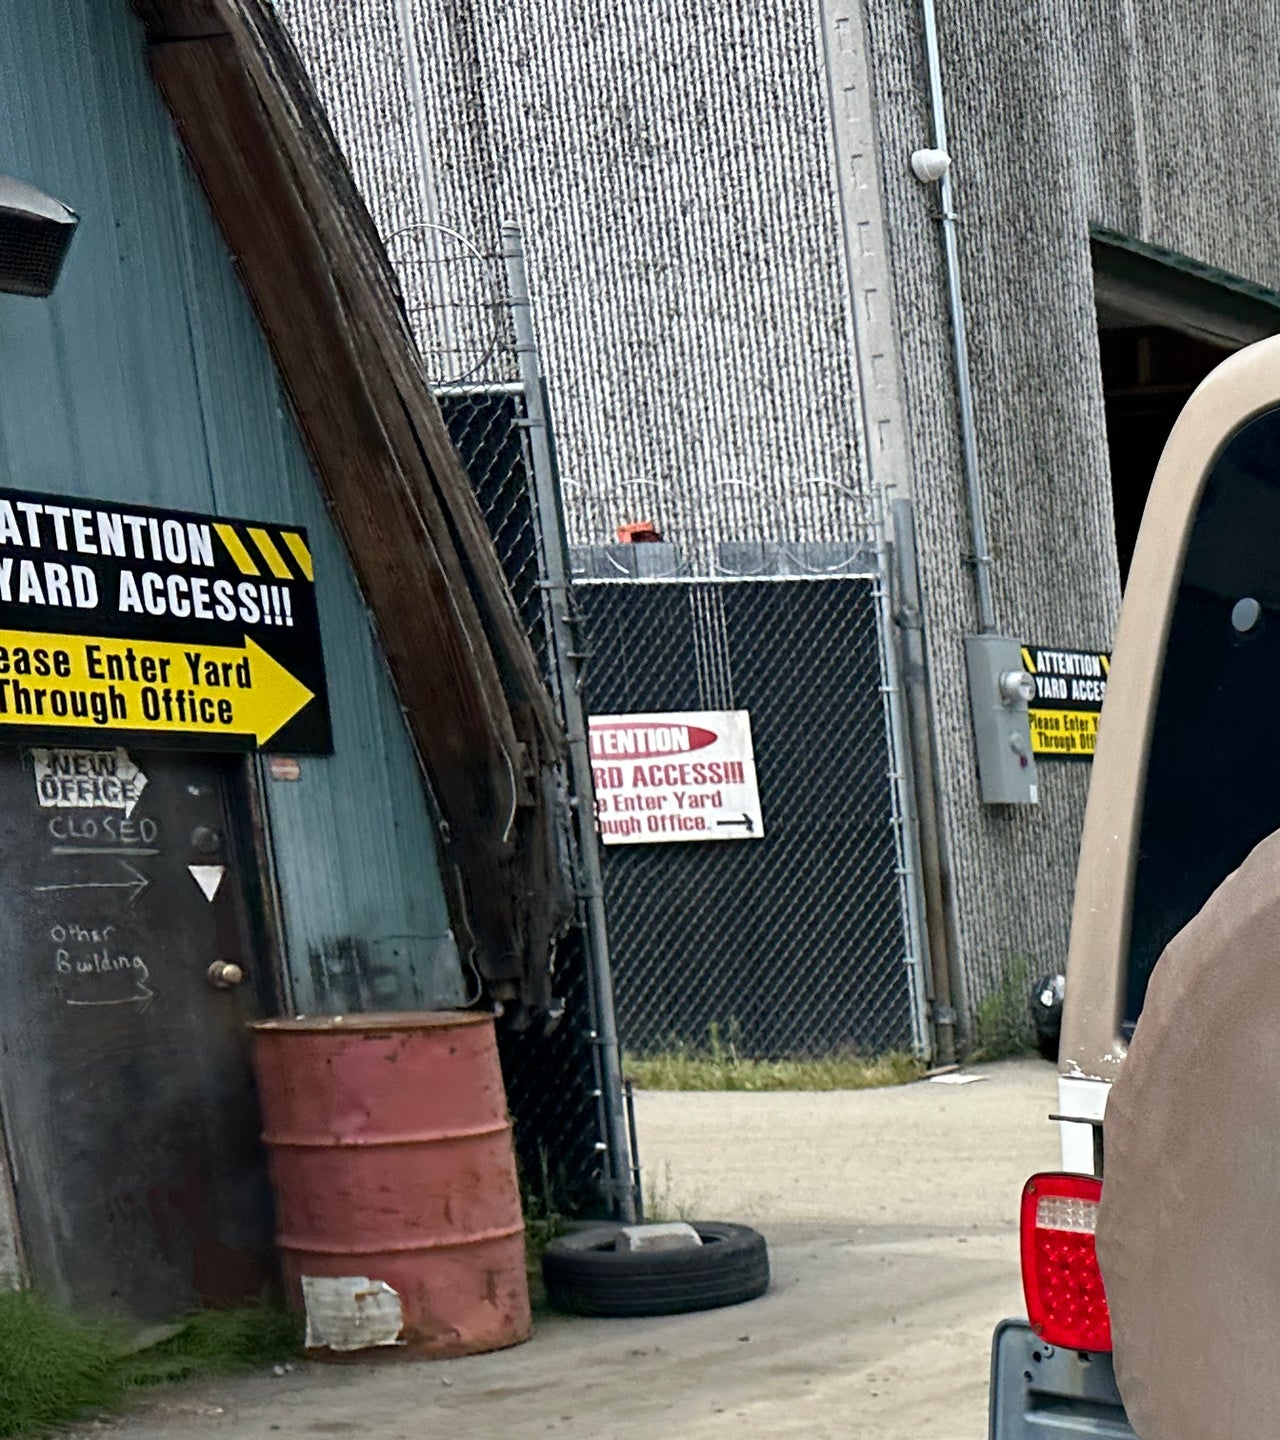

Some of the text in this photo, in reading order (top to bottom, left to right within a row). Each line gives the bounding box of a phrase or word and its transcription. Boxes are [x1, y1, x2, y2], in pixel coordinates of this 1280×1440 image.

[0, 499, 215, 567] ATTENTION
[0, 557, 294, 627] YARD ACCESS!!!
[85, 645, 170, 683] Enter
[184, 652, 252, 689] Yard
[1036, 651, 1101, 677] ATTENTION
[1035, 675, 1068, 699] YARD
[0, 678, 234, 725] Through Office
[1063, 714, 1089, 732] Enter
[1037, 731, 1076, 752] Through
[47, 750, 117, 776] NEW
[632, 761, 745, 788] ACCESS!!!
[612, 793, 667, 812] Enter
[673, 790, 722, 809] Yard
[49, 816, 157, 842] CLOSED
